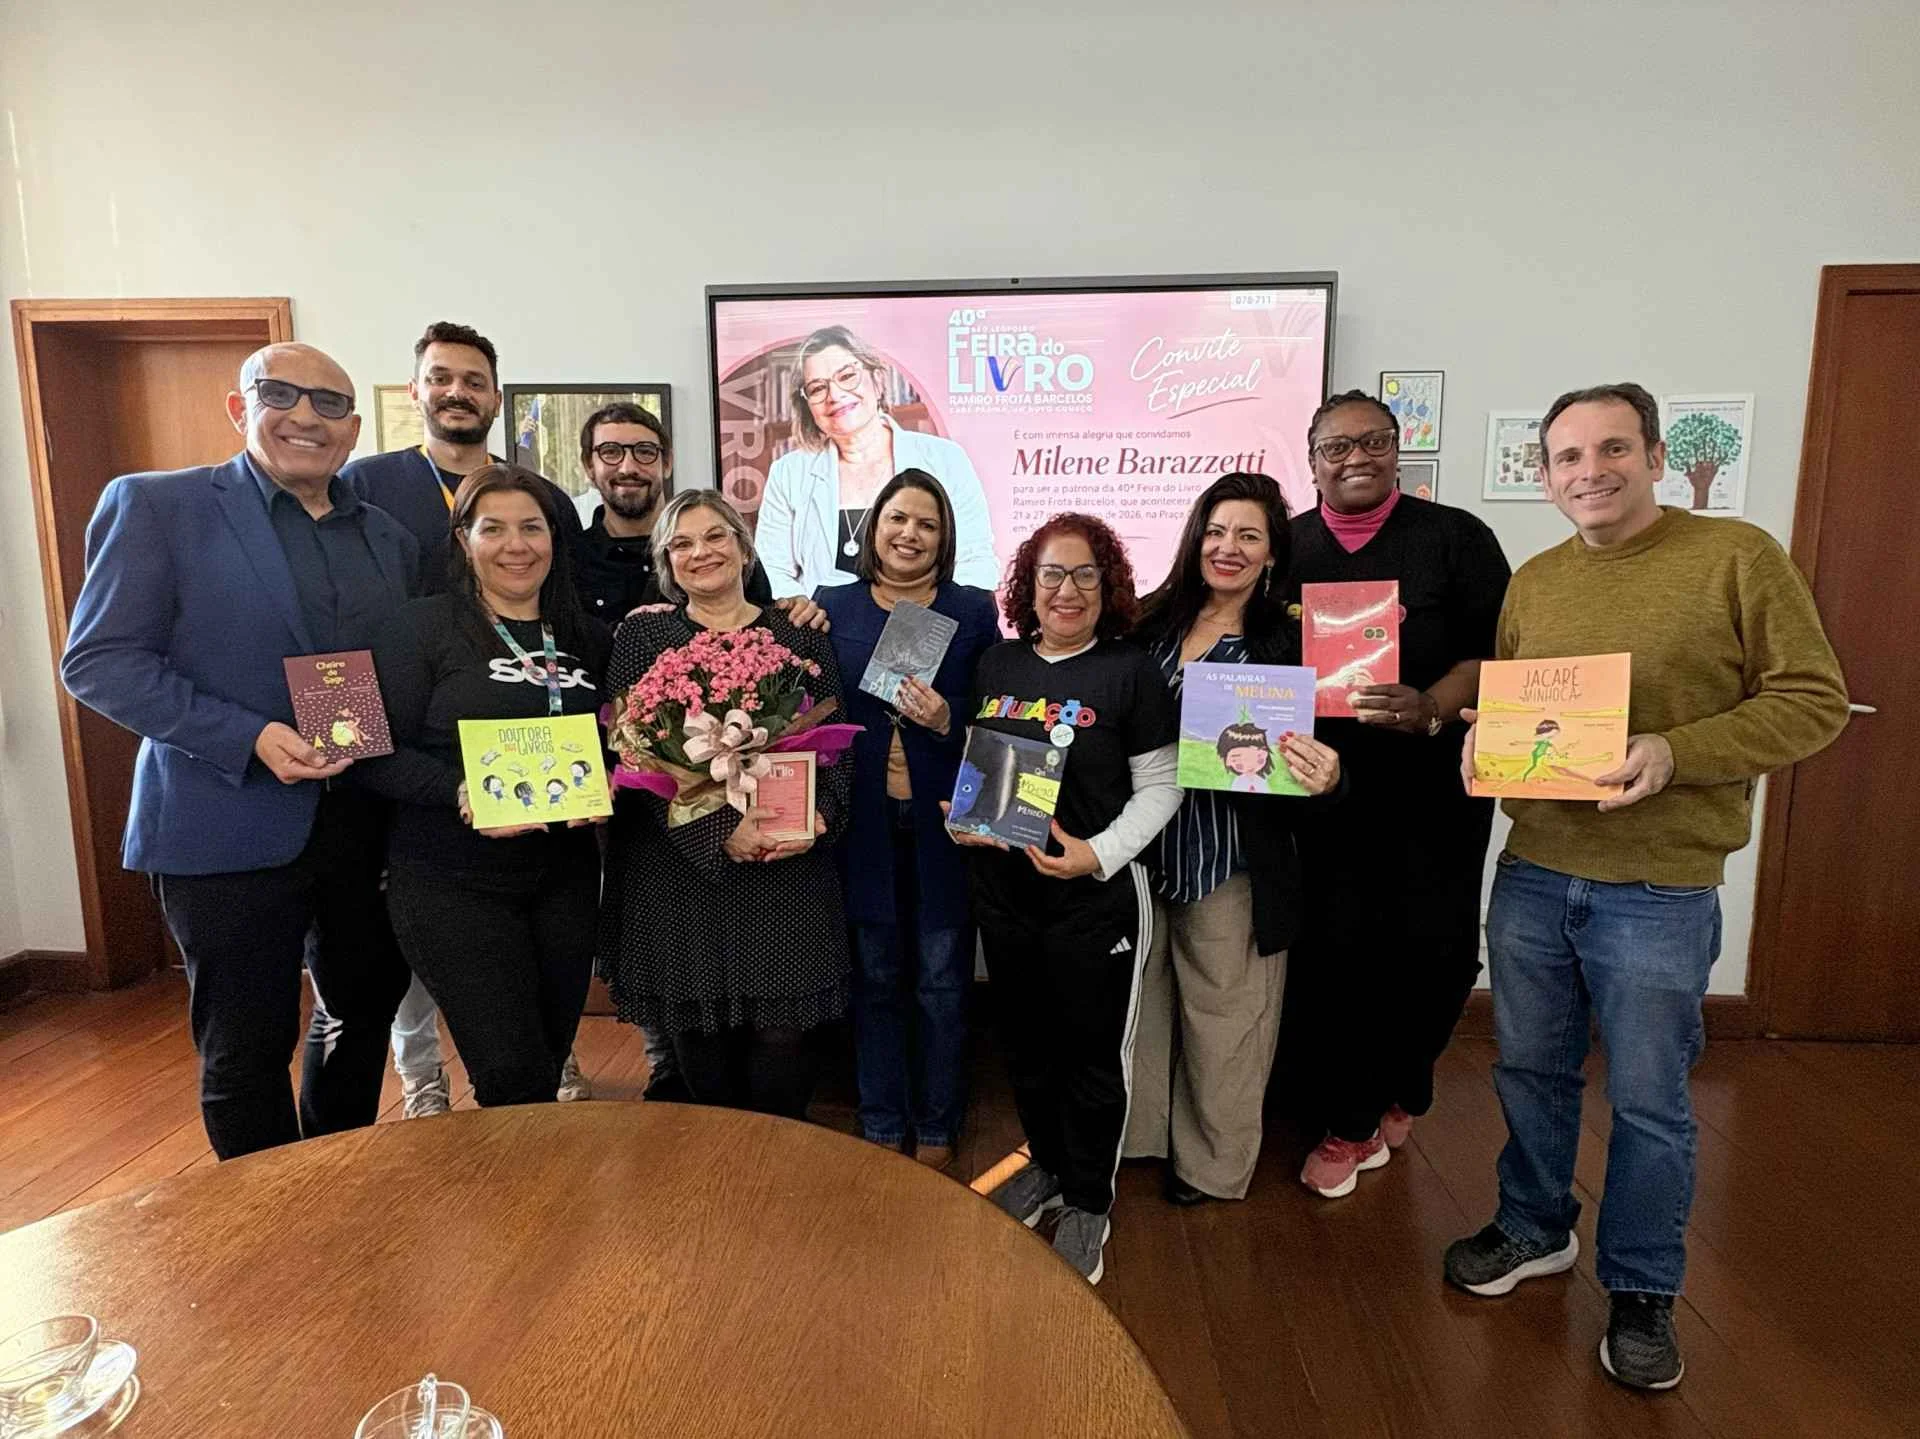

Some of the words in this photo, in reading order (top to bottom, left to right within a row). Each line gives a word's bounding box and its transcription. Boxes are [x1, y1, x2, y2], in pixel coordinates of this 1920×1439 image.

[1041, 337, 1065, 355] do
[1130, 327, 1242, 382] Convite
[948, 354, 1094, 393] LIVRO
[1147, 358, 1262, 413] Especial
[949, 394, 992, 405] RAMIRO
[995, 394, 1032, 405] FROTA
[1033, 392, 1093, 405] BARCELOS
[1022, 432, 1043, 440] com
[1046, 431, 1080, 440] imensa
[1082, 430, 1113, 442] alegria
[1115, 432, 1133, 442] que
[1136, 430, 1192, 440] convidamos
[1012, 445, 1110, 476] Milene
[1116, 447, 1266, 475] Barazzetti
[1012, 486, 1034, 494] para
[1061, 485, 1100, 494] patrona
[1102, 484, 1115, 493] da
[1137, 484, 1160, 493] Feira
[1162, 484, 1176, 492] do
[1178, 483, 1202, 493] Livro
[1012, 497, 1046, 506] Ramiro
[1047, 497, 1072, 506] Frota
[1120, 498, 1138, 507] que
[1033, 511, 1044, 519] 27
[1105, 510, 1116, 519] de
[1206, 672, 1218, 682] AS
[1220, 672, 1267, 682] PALAVRAS
[1522, 665, 1580, 688] JACARÉ
[1235, 685, 1297, 699] MELINA
[1520, 687, 1580, 703] MINHOCA
[498, 726, 553, 744] DOUTORA
